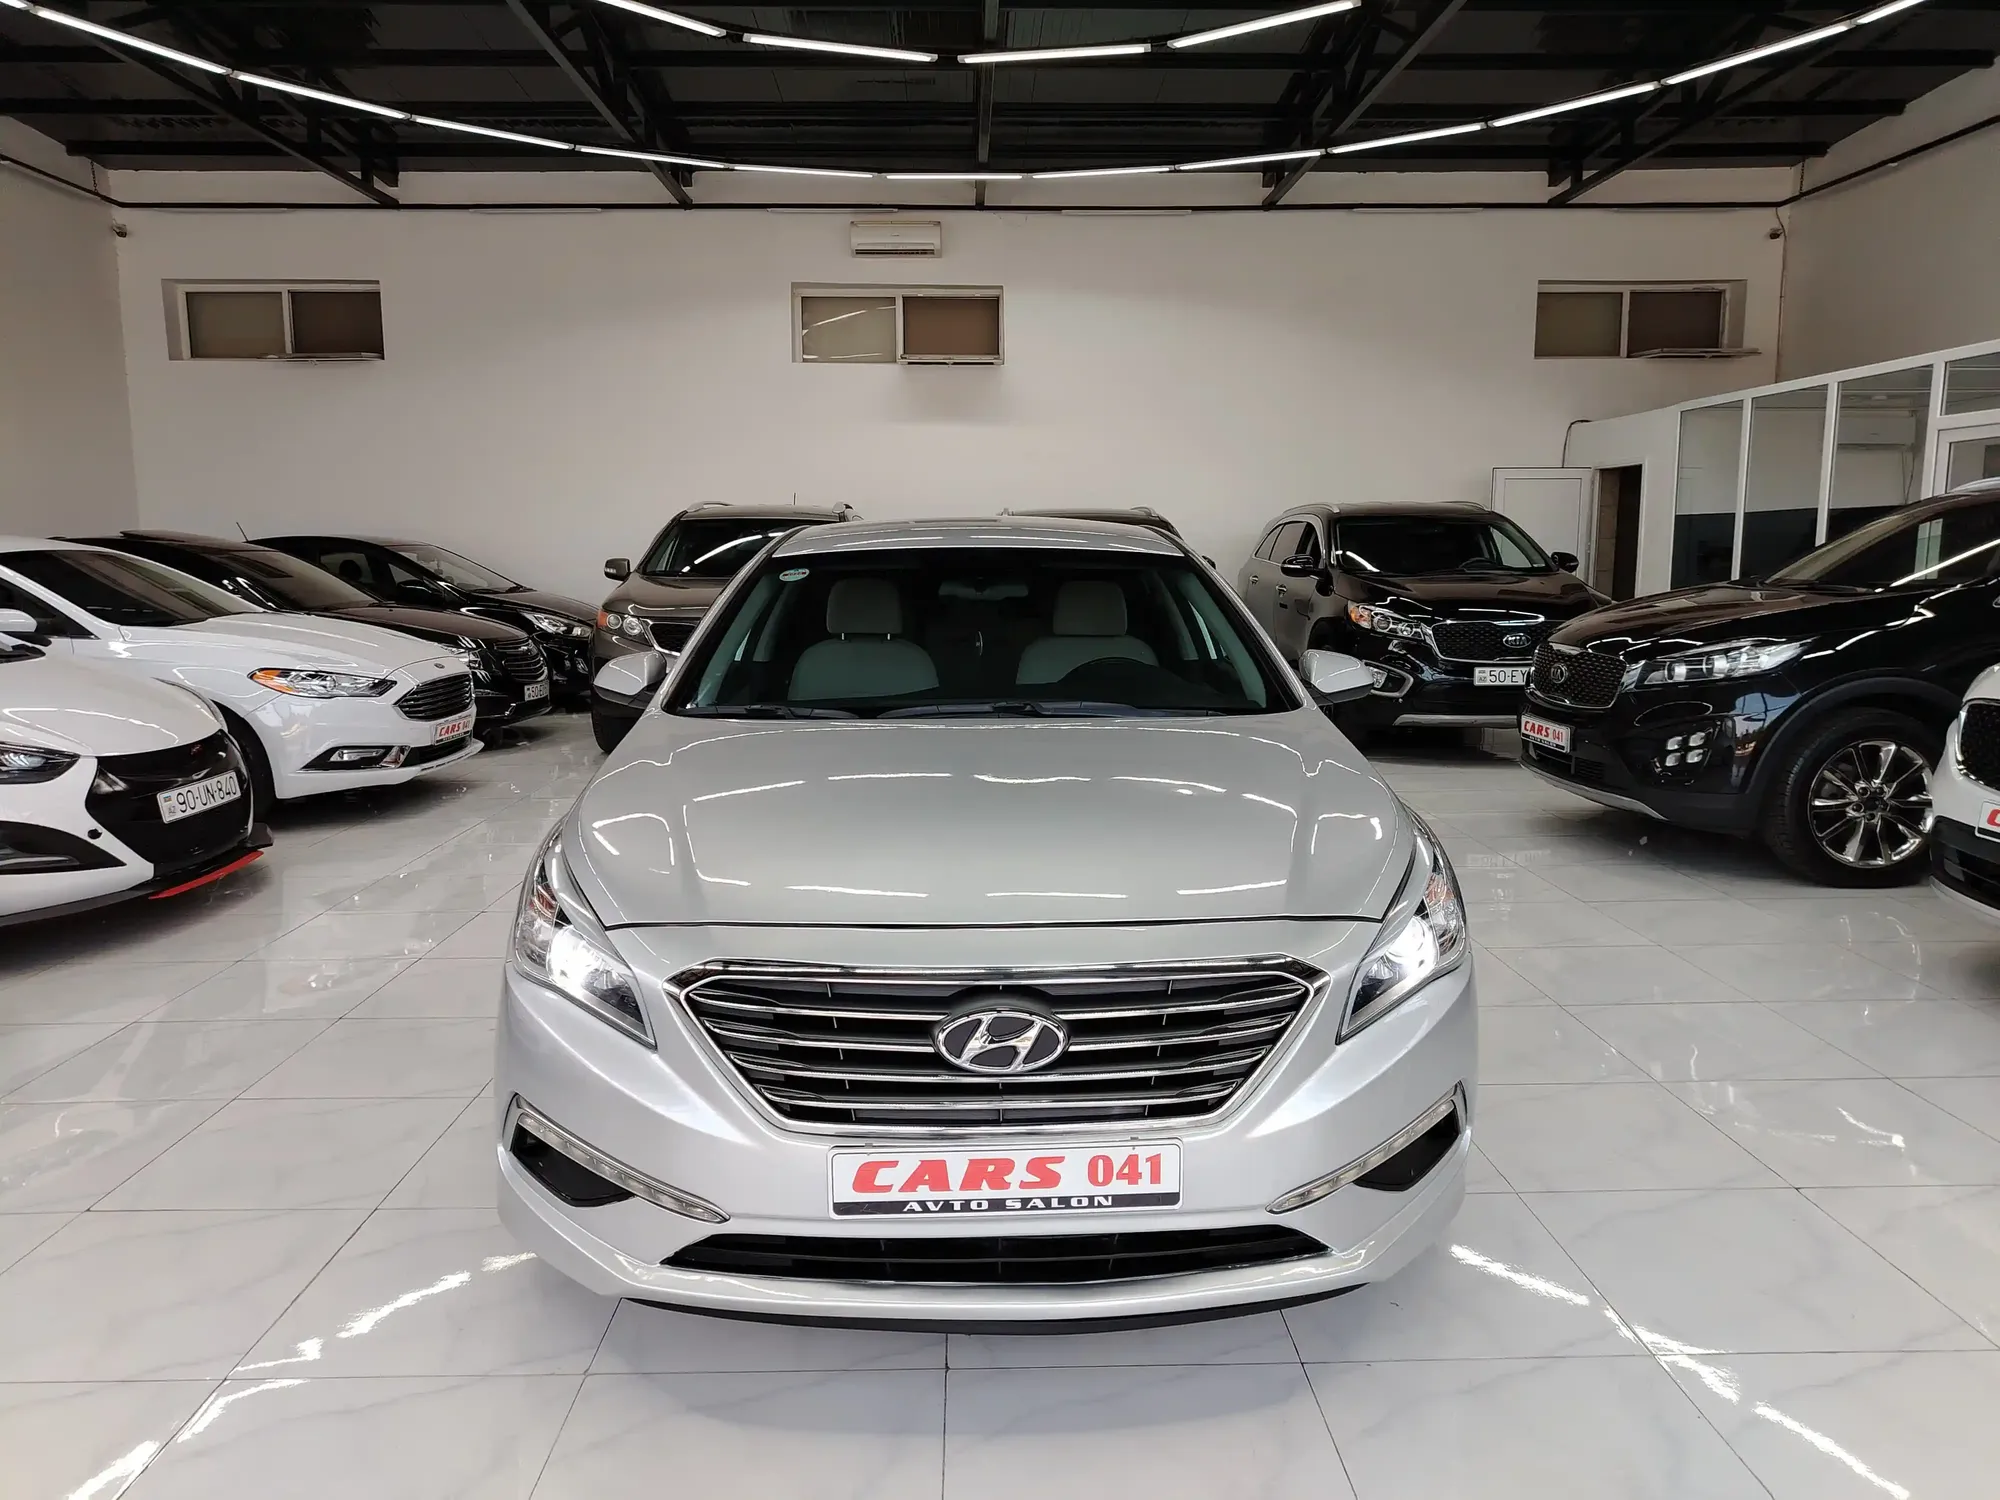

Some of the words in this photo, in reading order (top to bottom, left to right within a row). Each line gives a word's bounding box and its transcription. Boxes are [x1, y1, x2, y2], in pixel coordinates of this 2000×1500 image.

[1507, 636, 1528, 645] KIA
[439, 721, 463, 737] CARS
[1524, 720, 1551, 738] CARS
[1552, 728, 1564, 742] 041
[176, 775, 237, 813] 90-UN-840
[852, 1155, 1066, 1193] CARS
[1087, 1153, 1163, 1187] 041
[903, 1198, 993, 1212] AVTO
[1005, 1194, 1114, 1211] SALON
